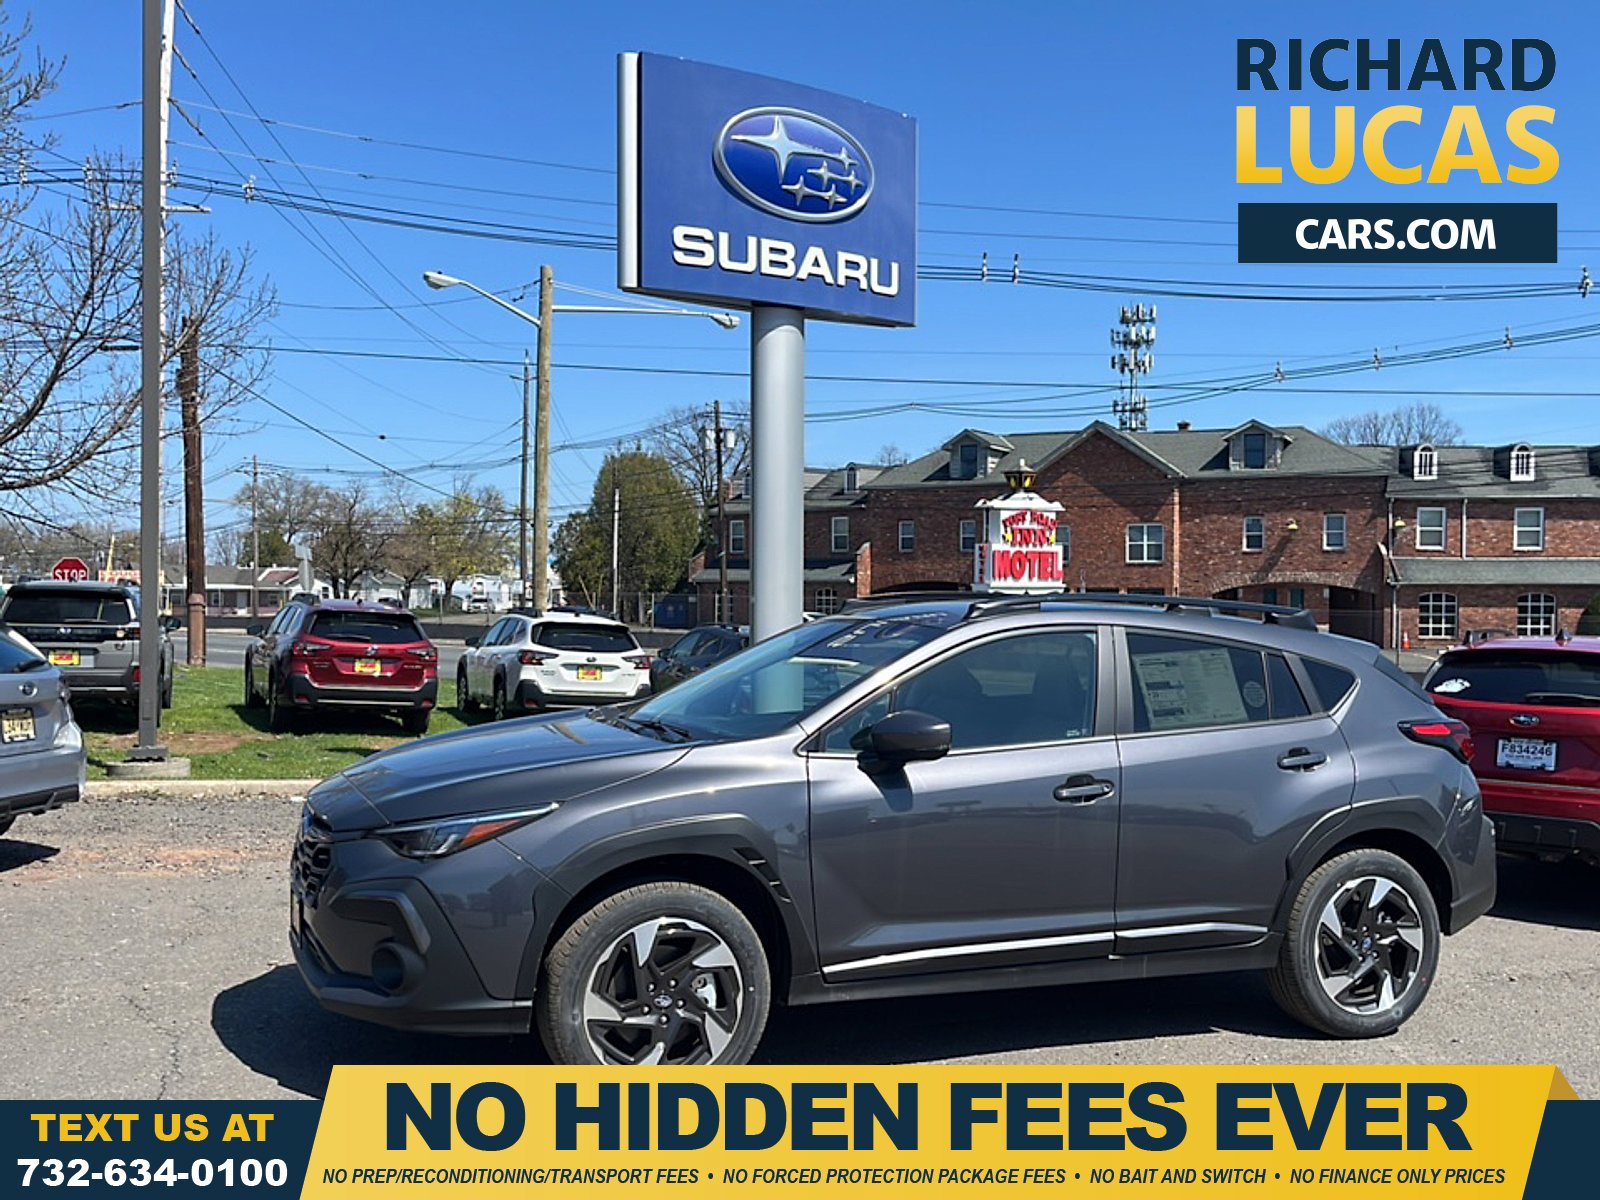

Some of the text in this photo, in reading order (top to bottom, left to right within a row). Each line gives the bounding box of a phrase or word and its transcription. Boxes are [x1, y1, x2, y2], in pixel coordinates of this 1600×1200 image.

[672, 224, 899, 296] SUBARU
[1011, 528, 1051, 546] INN
[54, 568, 87, 581] STOP
[993, 550, 1064, 581] MOTEL
[1501, 743, 1553, 757] F834246
